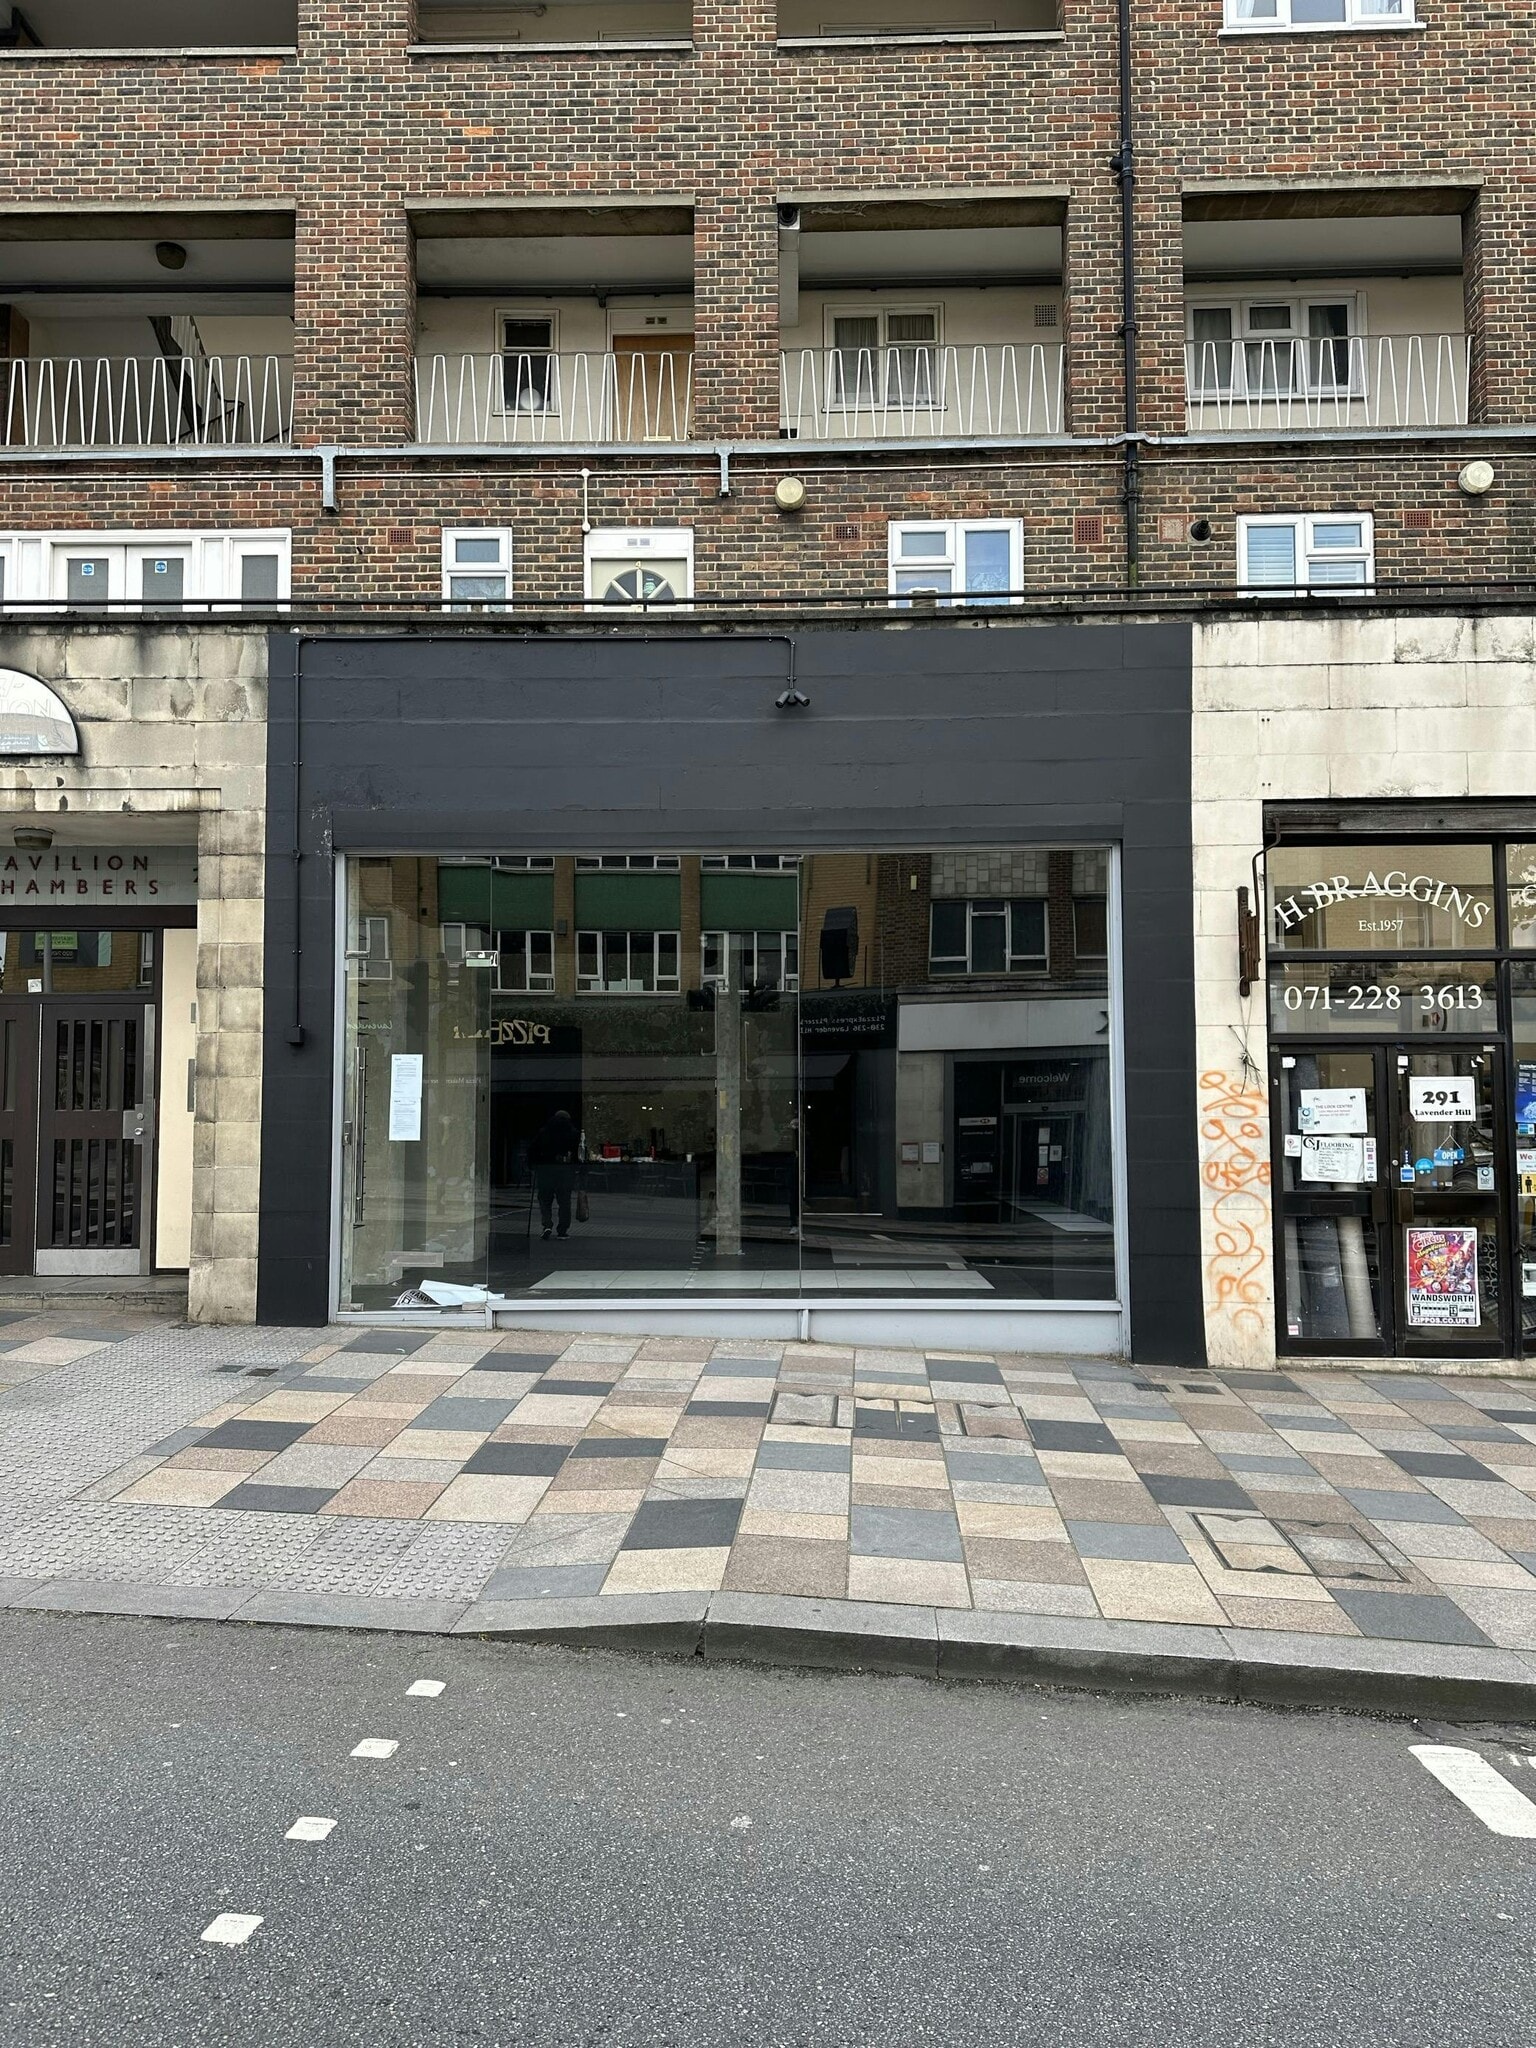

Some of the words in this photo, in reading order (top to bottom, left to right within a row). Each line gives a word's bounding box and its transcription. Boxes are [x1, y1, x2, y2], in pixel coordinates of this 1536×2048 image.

[1283, 984, 1402, 1011] 071-228
[1420, 984, 1483, 1011] 3613
[1422, 1090, 1461, 1106] 291
[1441, 1151, 1458, 1160] OPEN
[1413, 1234, 1445, 1251] CIRCUS
[1412, 1294, 1474, 1302] WANDSWORTH
